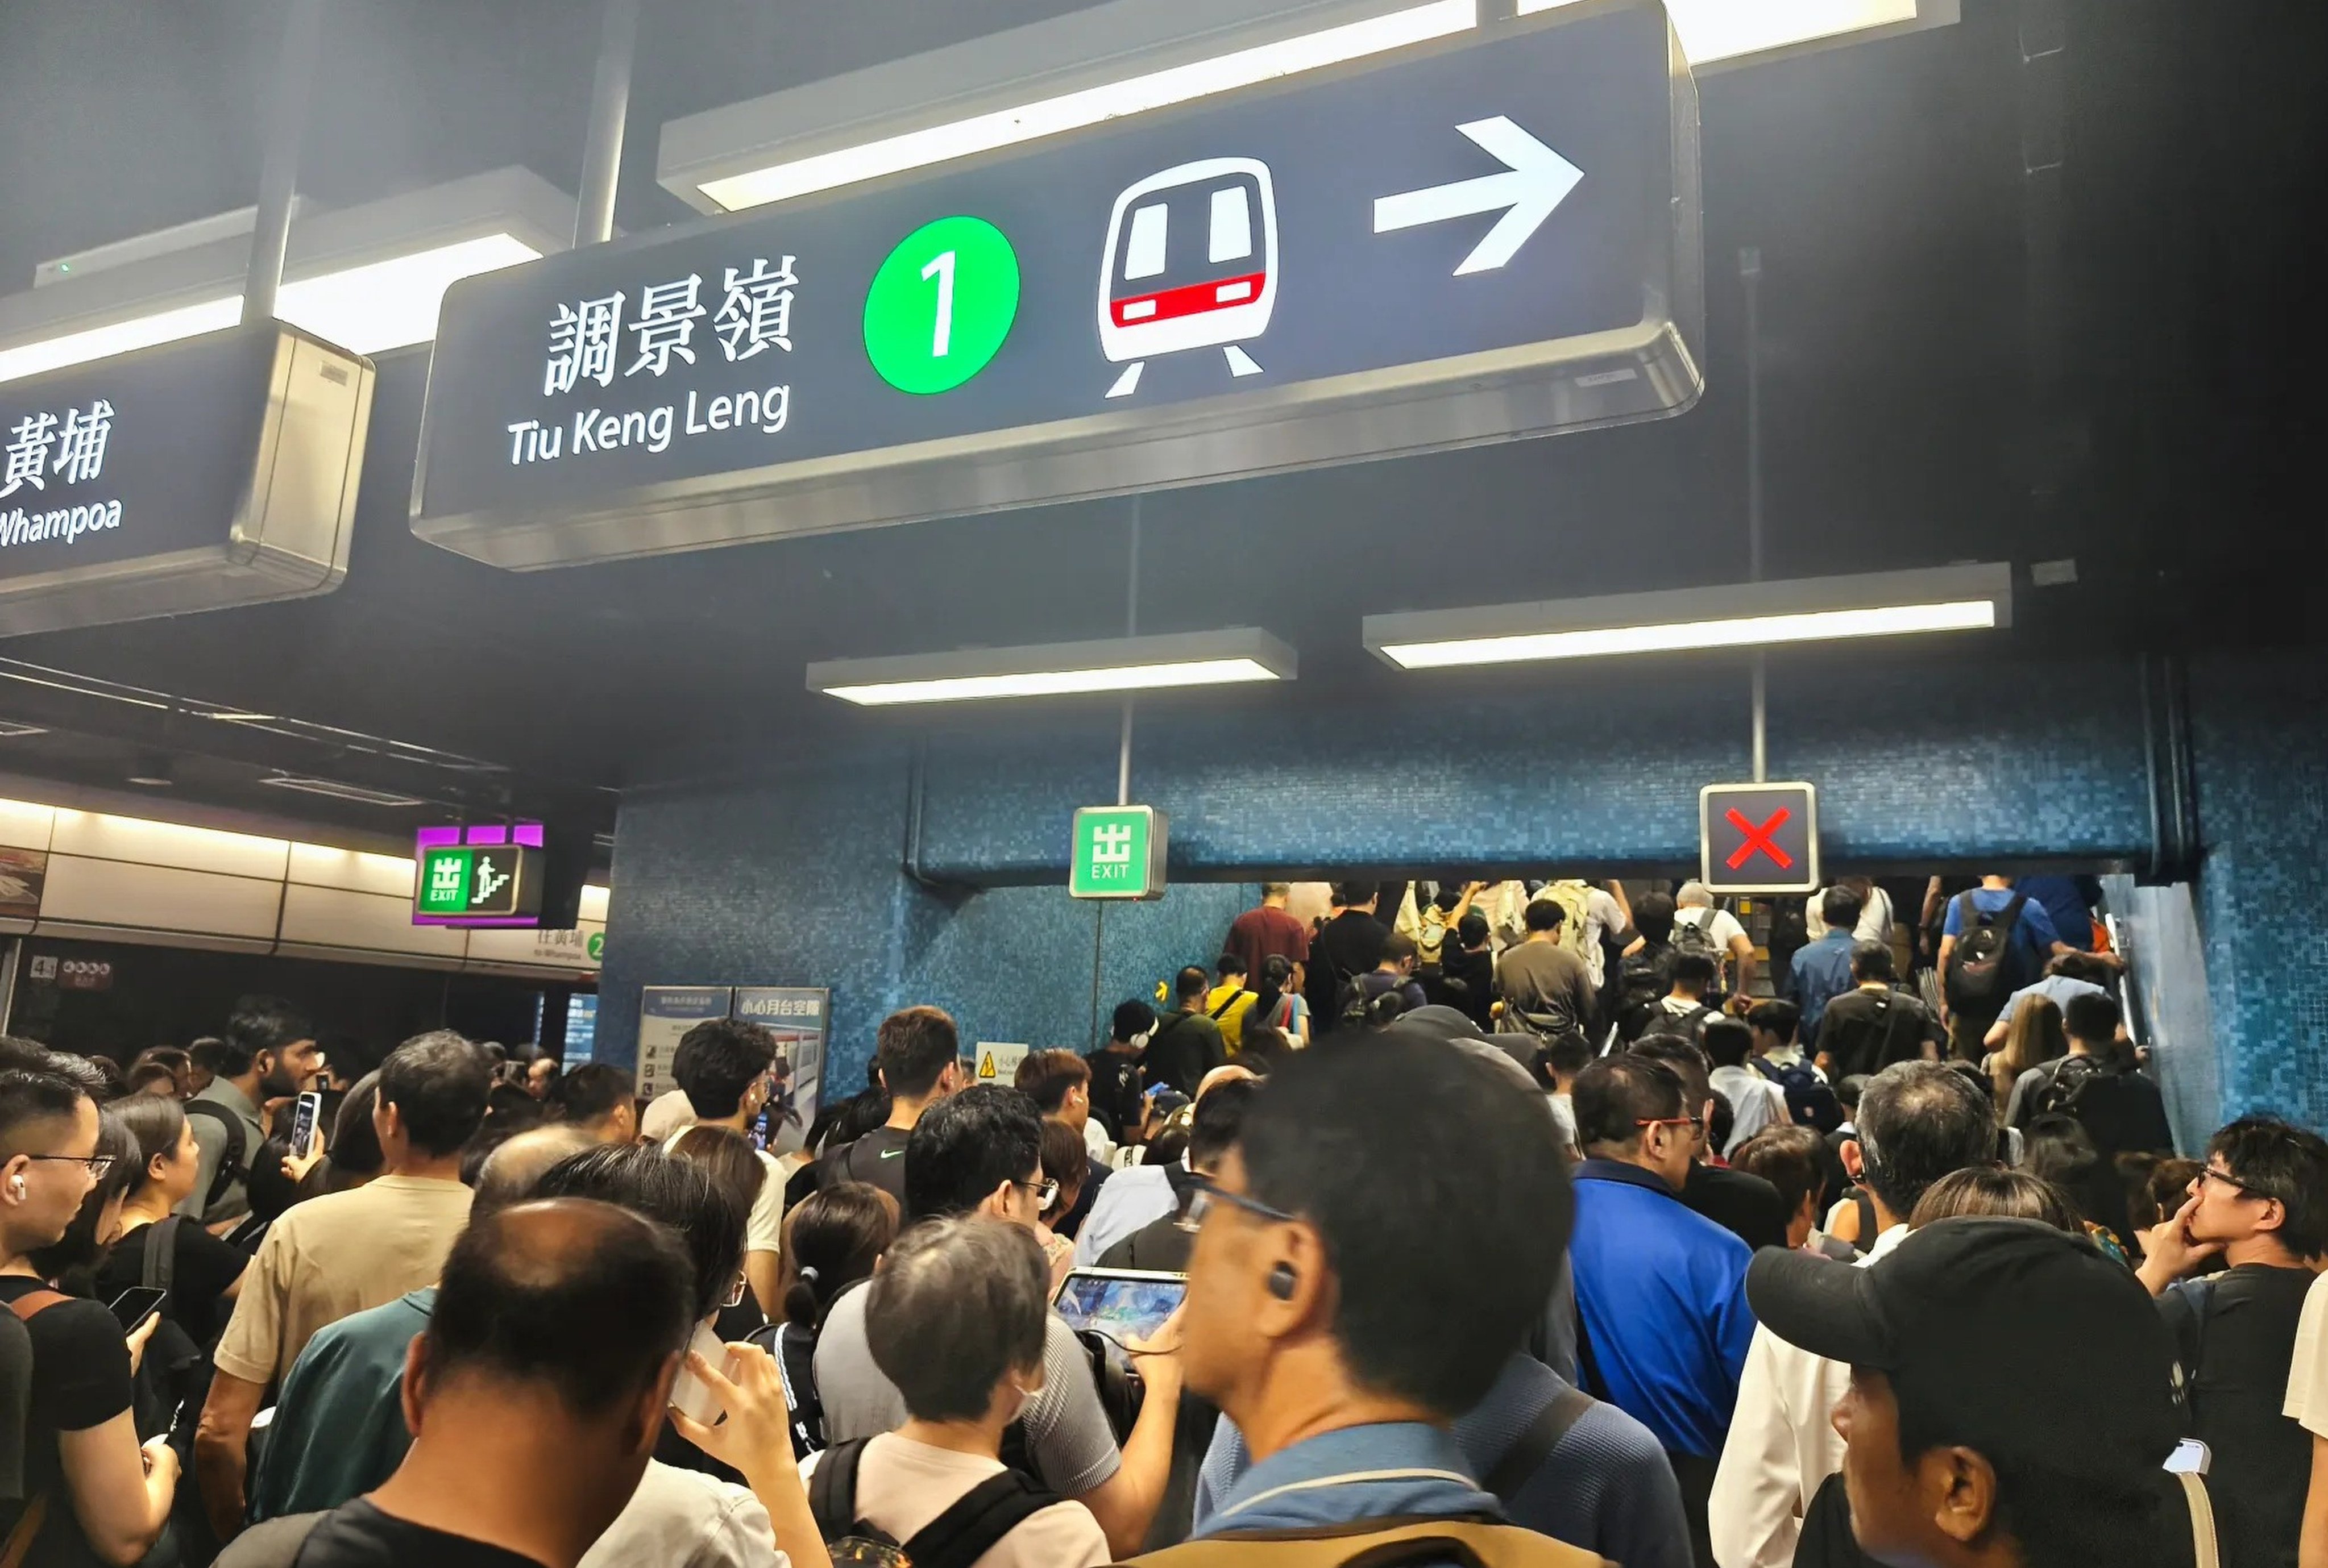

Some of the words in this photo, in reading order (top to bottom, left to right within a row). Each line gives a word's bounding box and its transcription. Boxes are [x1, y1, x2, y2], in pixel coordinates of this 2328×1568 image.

[920, 250, 956, 357] 1
[544, 255, 799, 396] 調景嶺
[508, 419, 563, 465] Tiu
[572, 405, 674, 454] Keng
[685, 385, 790, 434] Leng
[0, 399, 114, 498] 黃埔
[1093, 823, 1131, 862] 出
[431, 857, 462, 889] 出
[1092, 864, 1130, 879] EXIT
[430, 889, 458, 901] EXIT
[592, 936, 604, 956] 2
